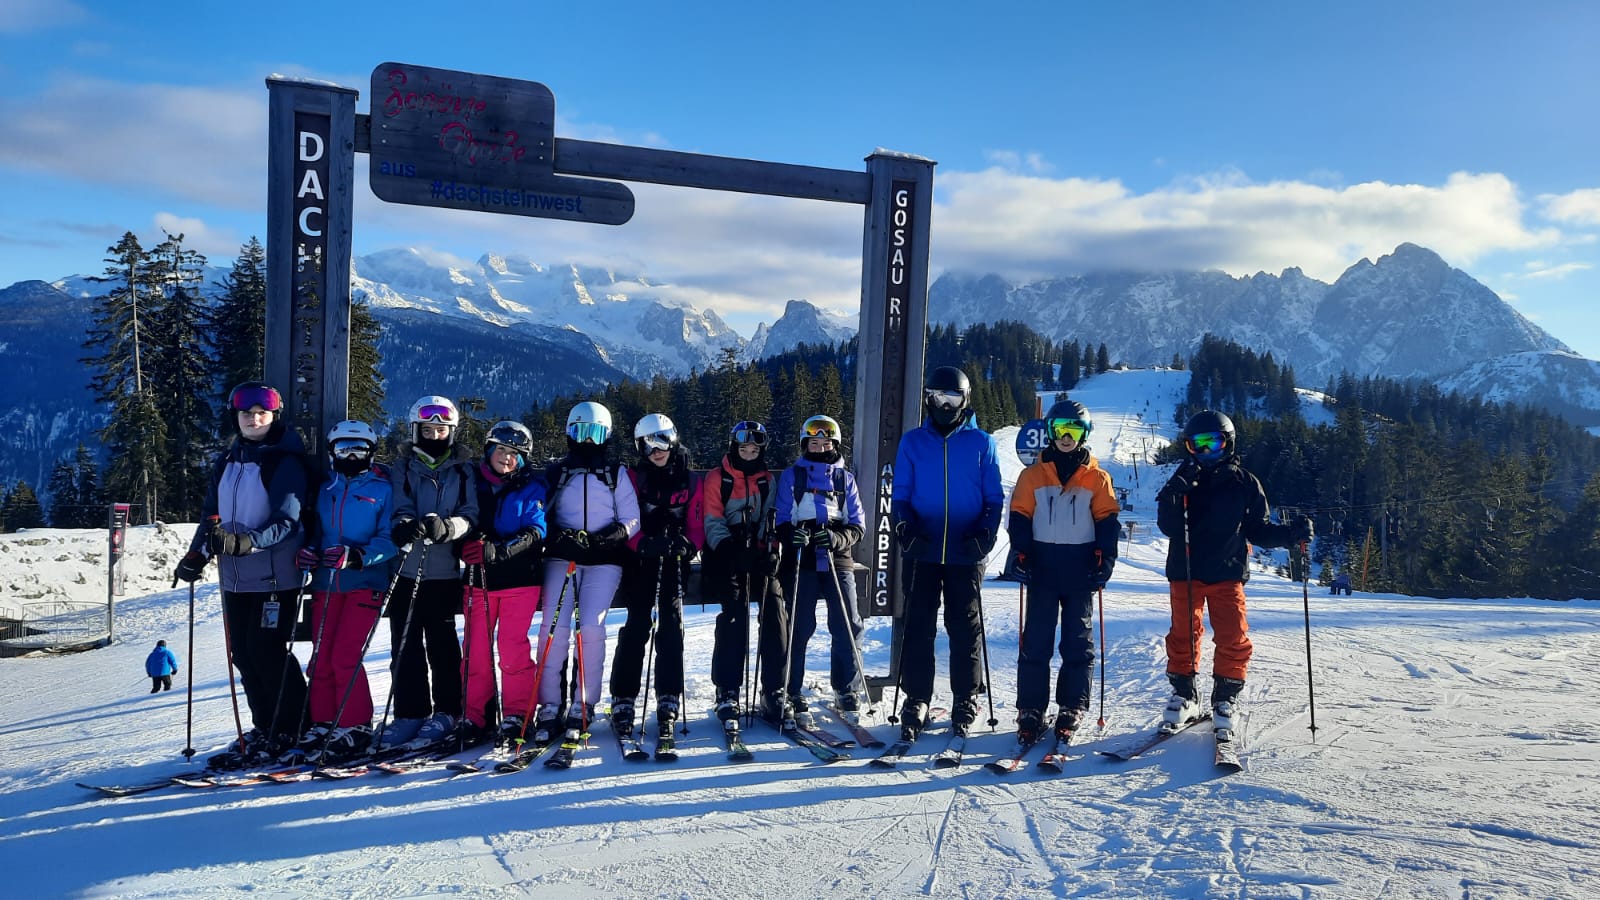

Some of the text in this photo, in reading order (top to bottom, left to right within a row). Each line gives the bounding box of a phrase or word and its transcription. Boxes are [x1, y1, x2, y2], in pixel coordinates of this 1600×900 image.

[380, 161, 417, 178] aus
[430, 180, 584, 213] #dachsteinwest
[875, 190, 908, 606] GOSAU RUACH ANNABERG
[1025, 428, 1050, 448] 3b
